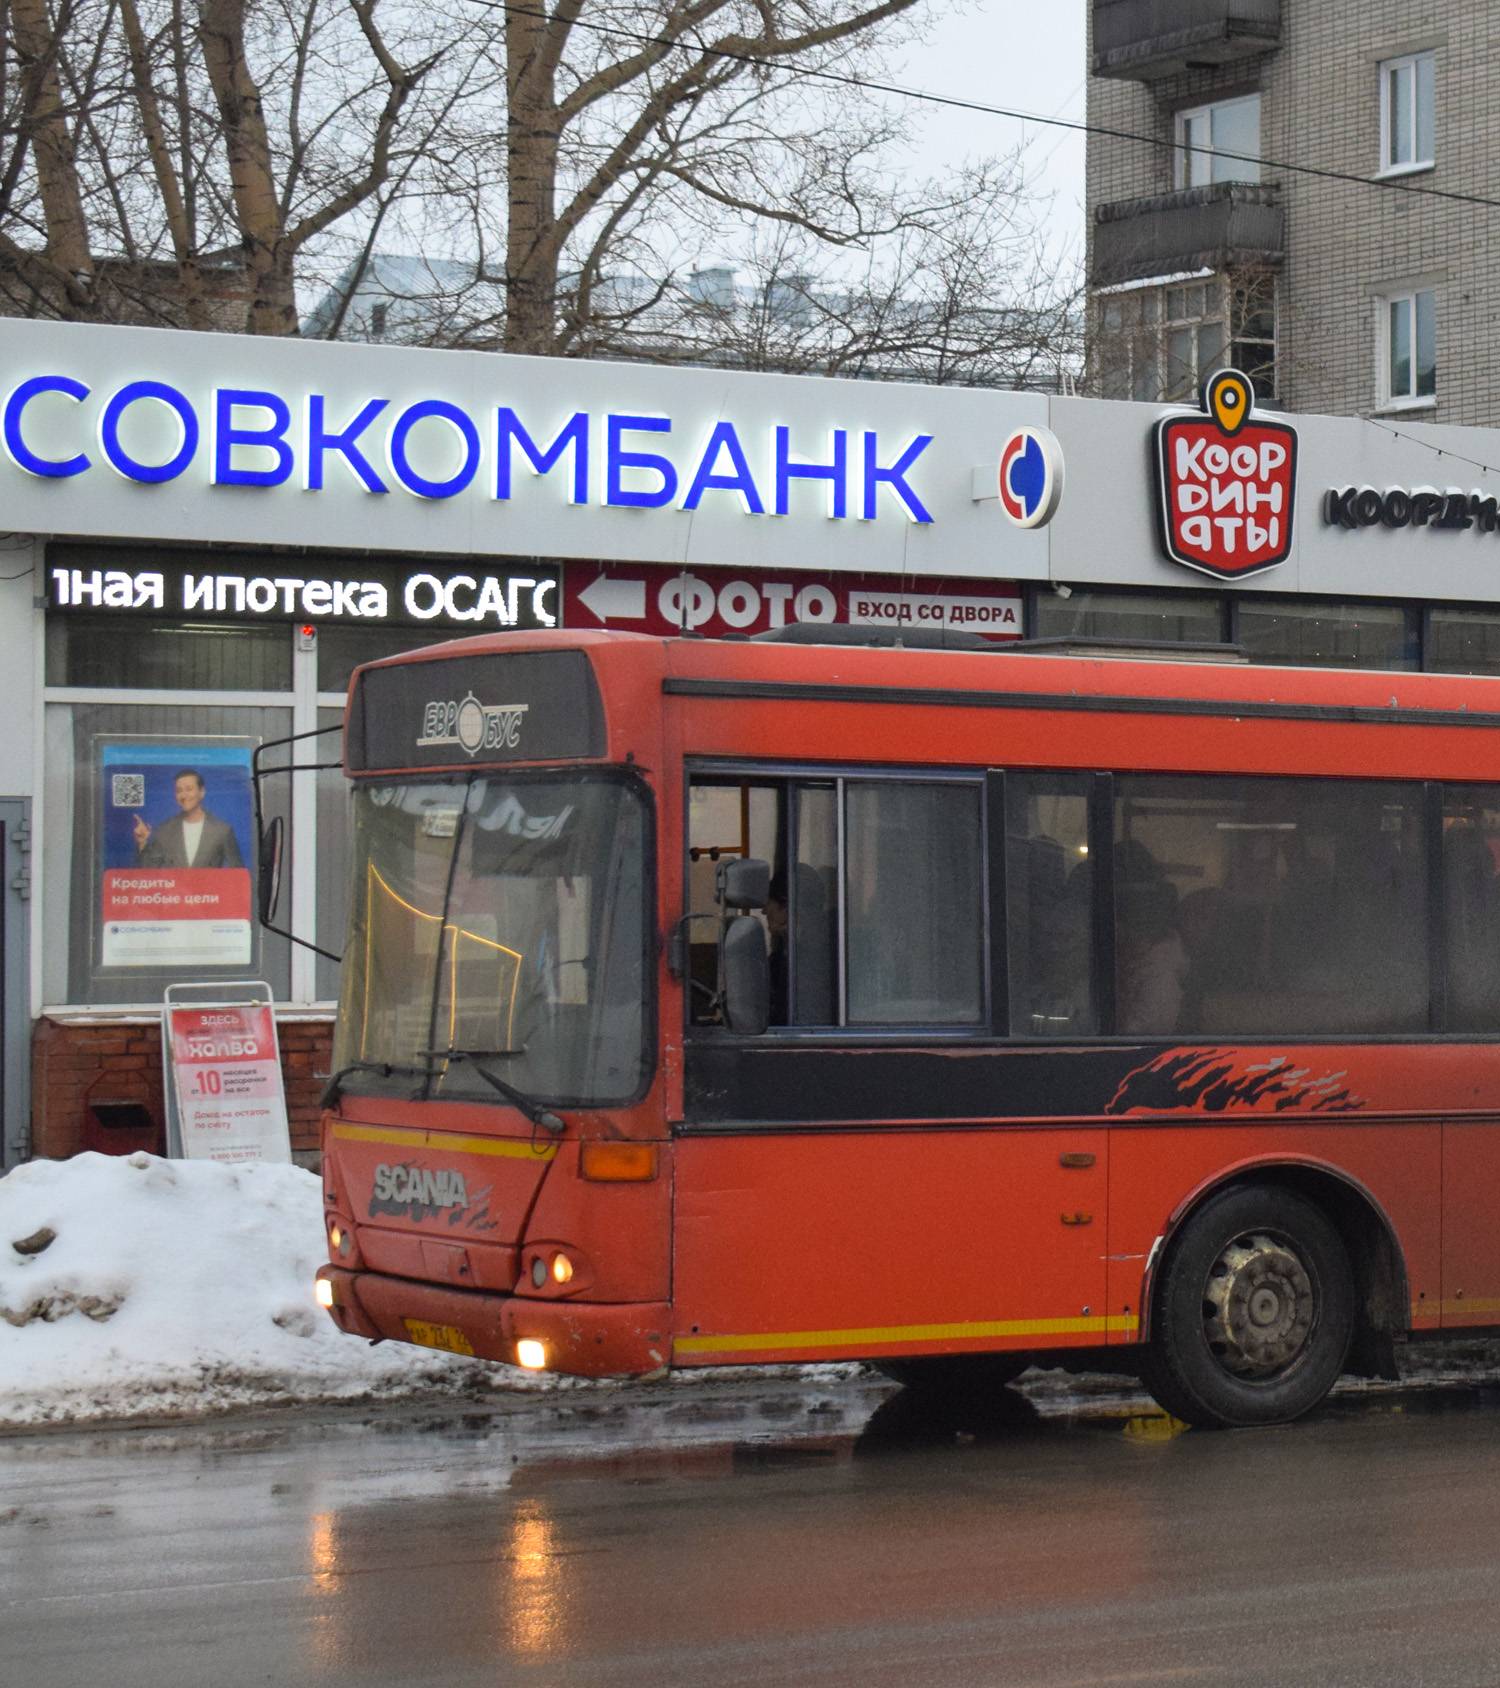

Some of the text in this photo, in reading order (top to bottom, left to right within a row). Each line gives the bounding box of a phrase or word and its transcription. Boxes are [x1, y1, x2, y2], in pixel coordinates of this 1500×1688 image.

[2, 374, 935, 525] СОВКОМБАНК
[1175, 436, 1286, 482] КООР
[182, 574, 388, 618] ипотека
[657, 571, 1017, 631] ФОТО ВХОД СО ДВОРА
[111, 878, 176, 891] Кредиты
[111, 892, 220, 907] на любые цели
[201, 1015, 239, 1026] ЗДЕСЬ
[196, 1070, 222, 1095] 10
[373, 1162, 470, 1209] SCANIA
